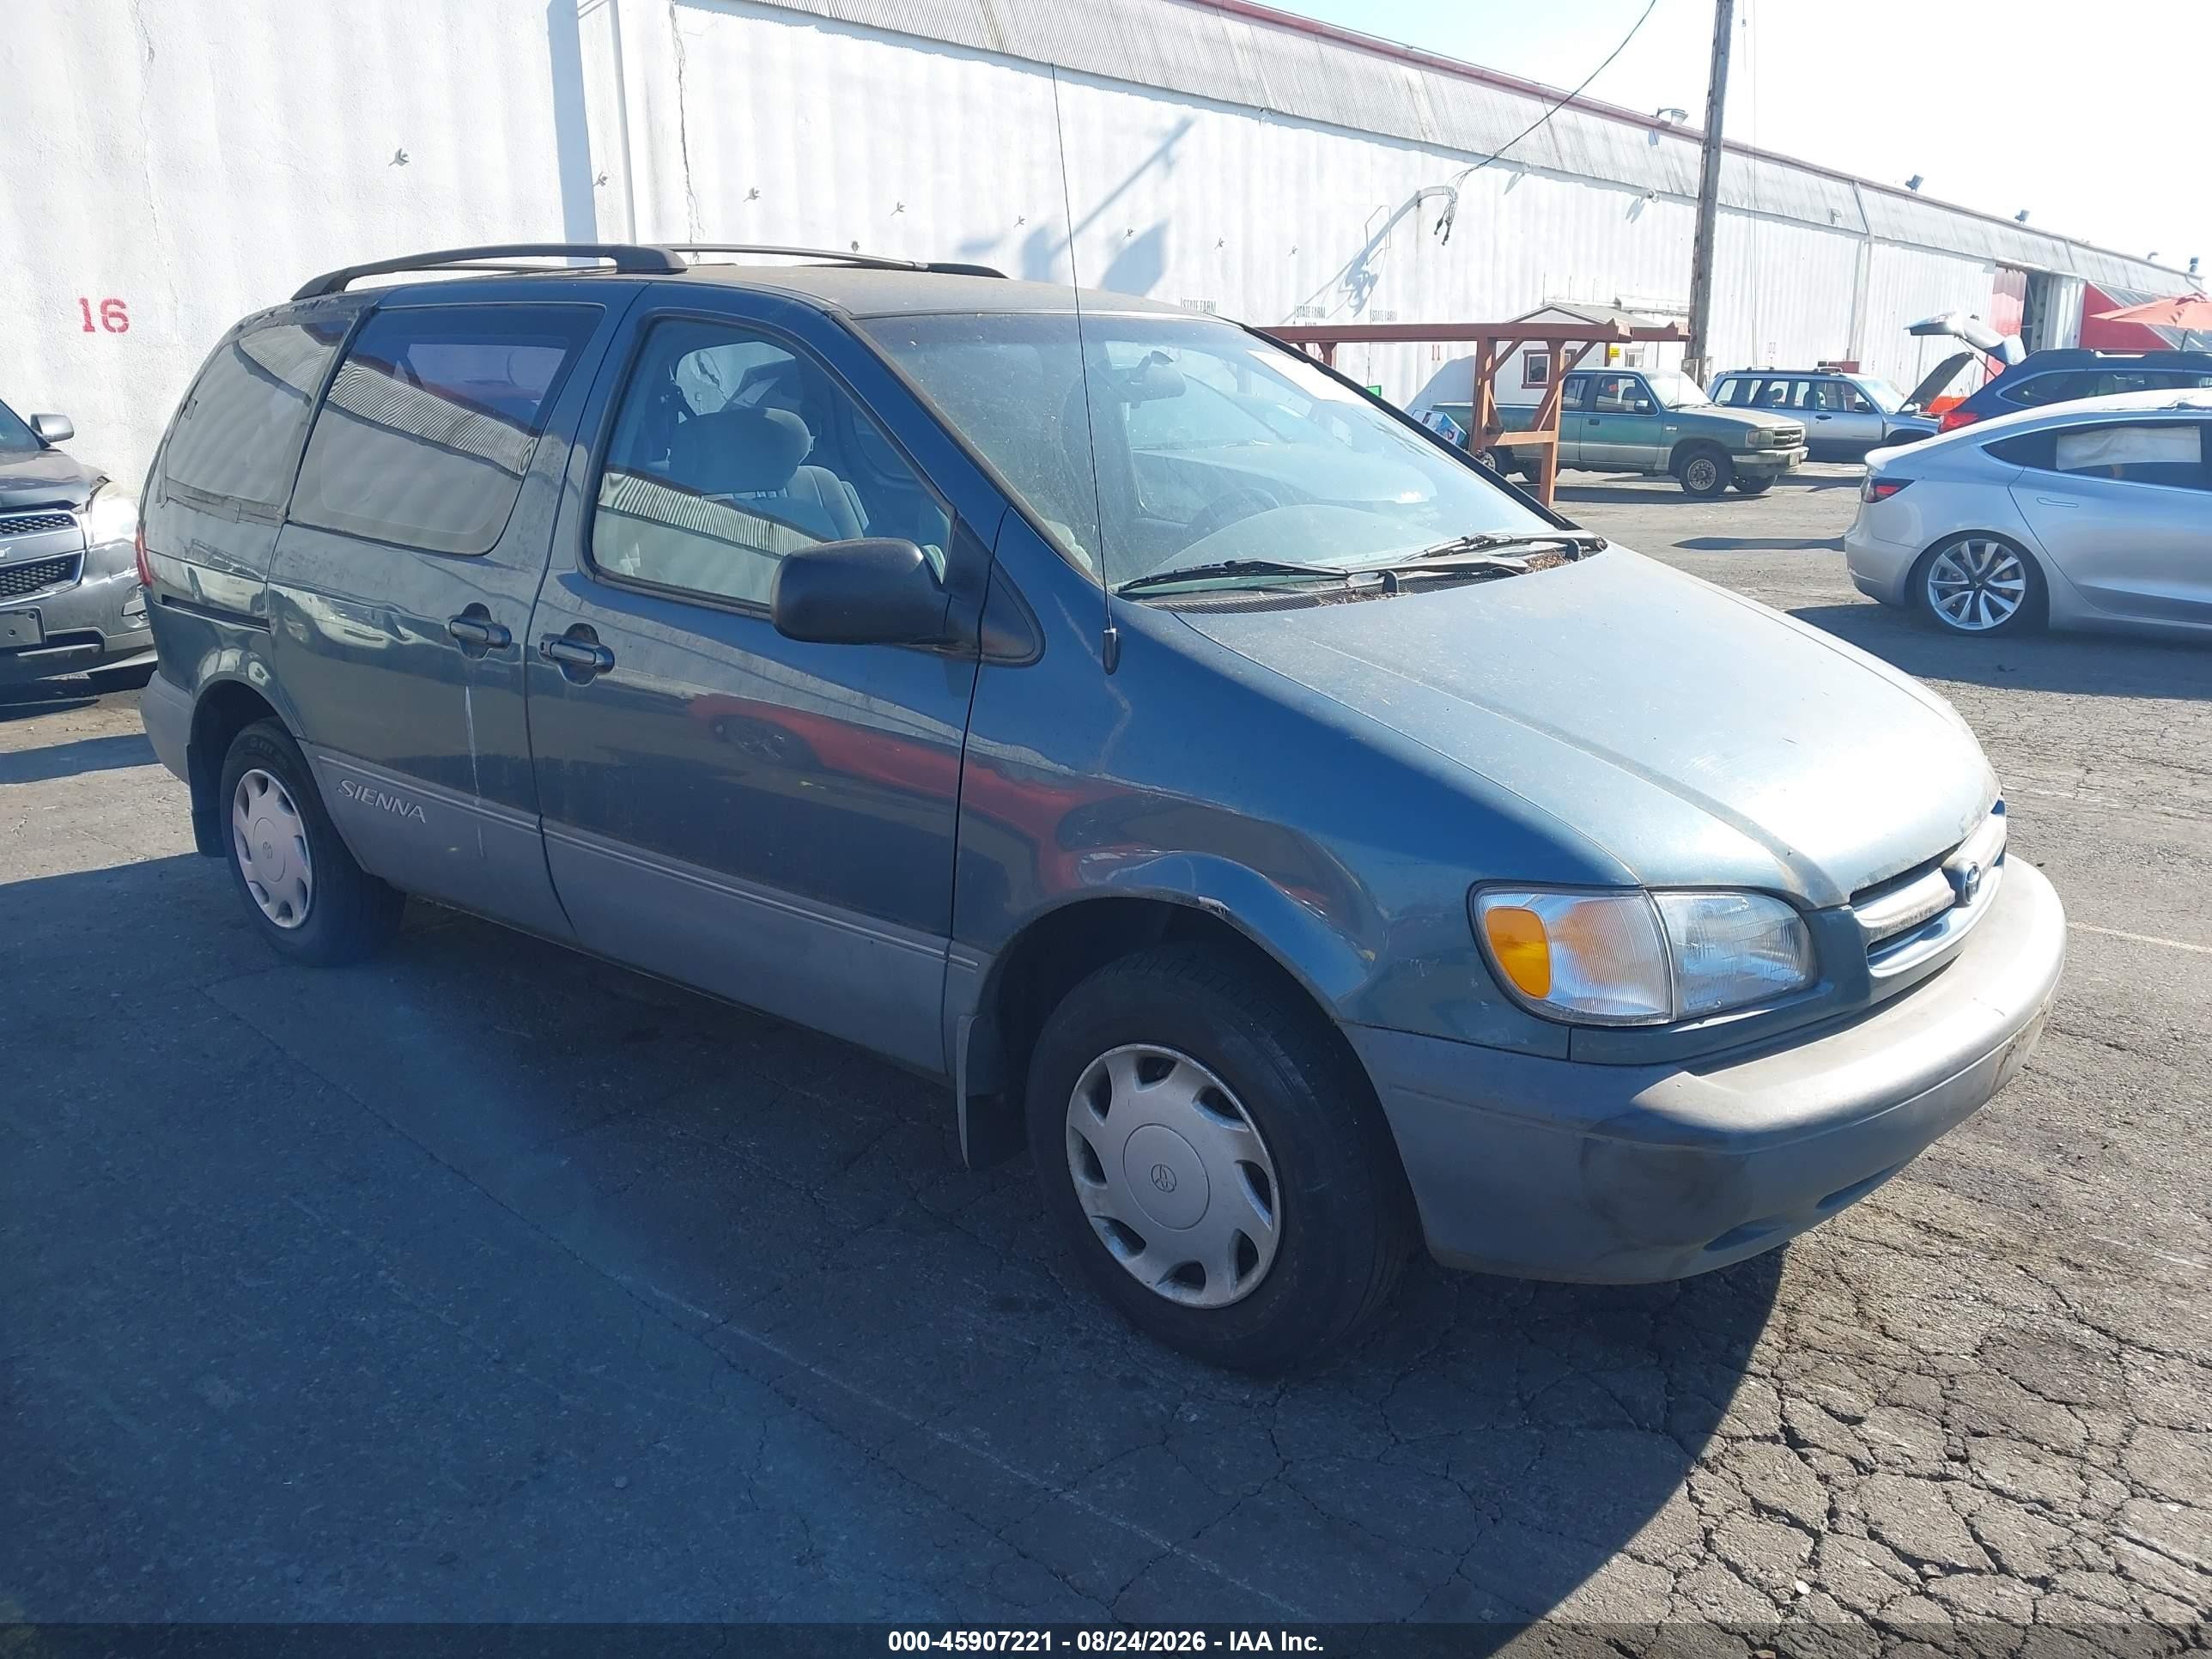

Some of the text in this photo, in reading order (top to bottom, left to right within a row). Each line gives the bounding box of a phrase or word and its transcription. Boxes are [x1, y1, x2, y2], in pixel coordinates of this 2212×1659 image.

[79, 297, 129, 333] 16
[1296, 305, 1326, 319] STATE FARM
[1371, 310, 1384, 322] STATE
[337, 779, 427, 824] SIENNA
